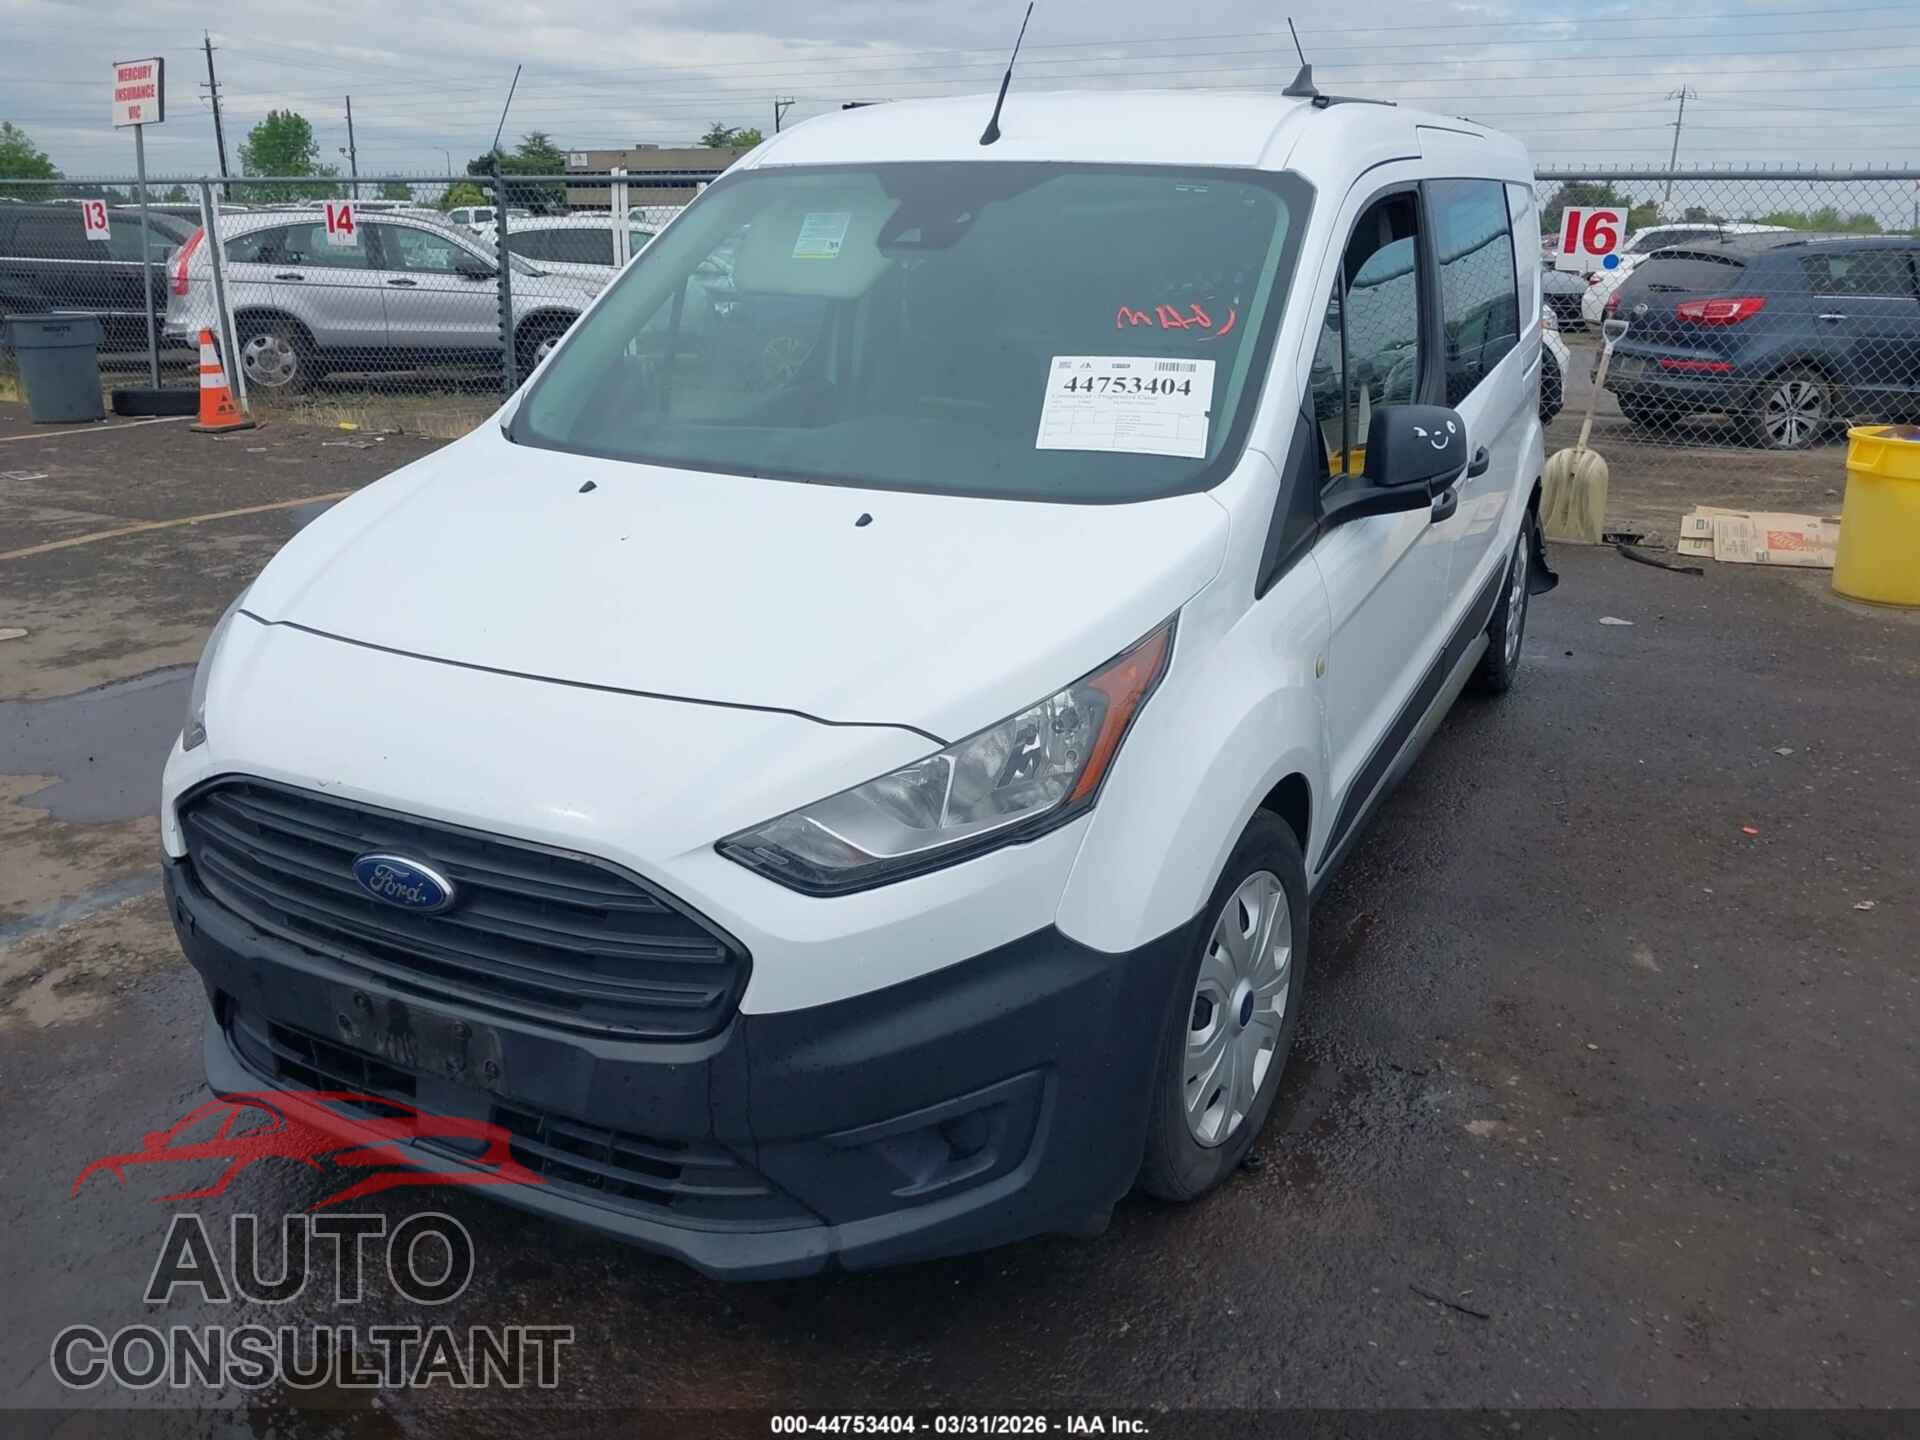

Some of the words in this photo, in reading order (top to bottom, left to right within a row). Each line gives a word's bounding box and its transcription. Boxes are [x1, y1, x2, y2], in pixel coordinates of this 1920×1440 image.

[117, 65, 152, 82] MERCURY
[114, 84, 155, 102] INSURANCE
[84, 202, 107, 230] 13
[325, 204, 355, 234] 14
[1563, 211, 1619, 256] 16
[1063, 375, 1192, 397] 44753404
[369, 864, 426, 903] Ford
